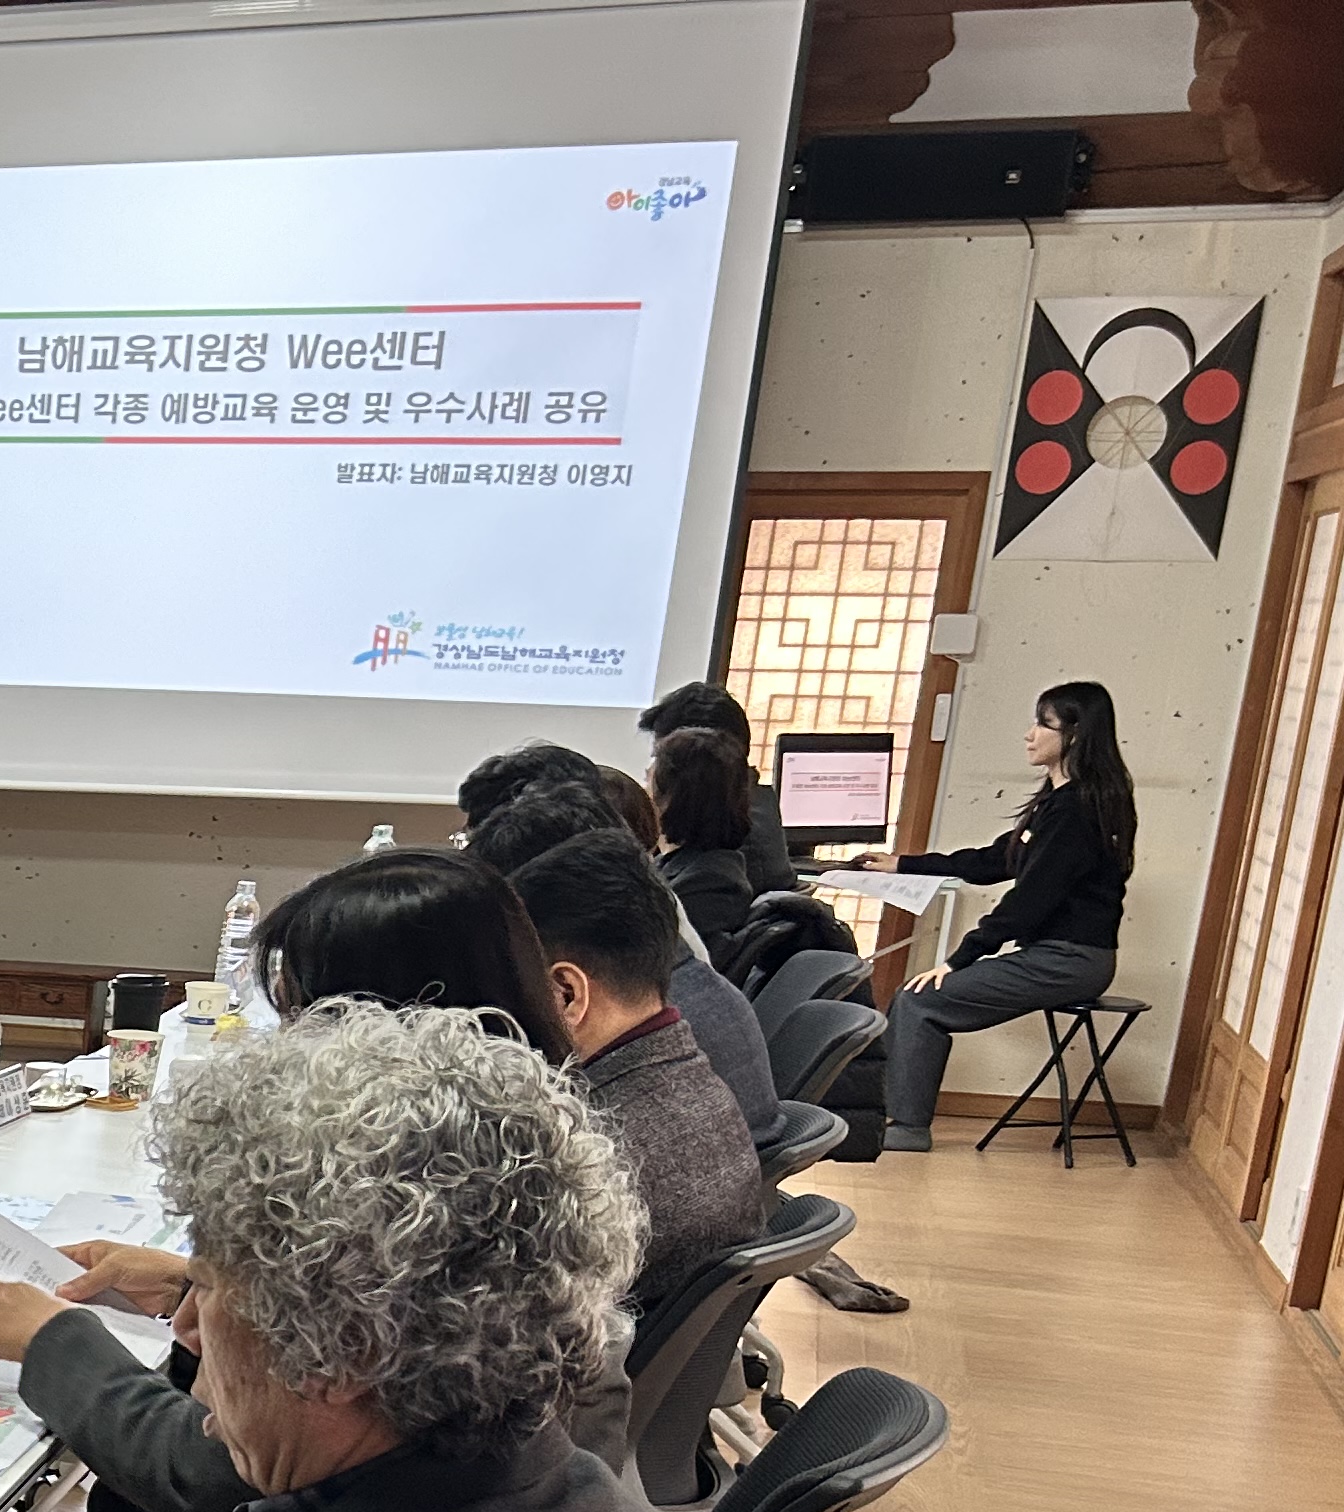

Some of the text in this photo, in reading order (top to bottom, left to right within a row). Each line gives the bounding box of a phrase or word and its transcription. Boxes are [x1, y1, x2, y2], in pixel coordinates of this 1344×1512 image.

[606, 188, 707, 221] 아이좋아
[17, 330, 447, 374] 남해교육지원청 Wee센터
[93, 392, 150, 425] 각종
[160, 392, 279, 425] 예방교육
[290, 391, 351, 425] 운영
[362, 392, 392, 425] 및
[403, 390, 532, 425] 우수사례
[543, 390, 609, 425] 공유
[336, 462, 633, 488] 발표자: 남해교육지원청 이영지
[432, 642, 626, 666] 경상남도남해교육지원청
[433, 661, 623, 676] NAMHAE OFFICE OF EDUCATION
